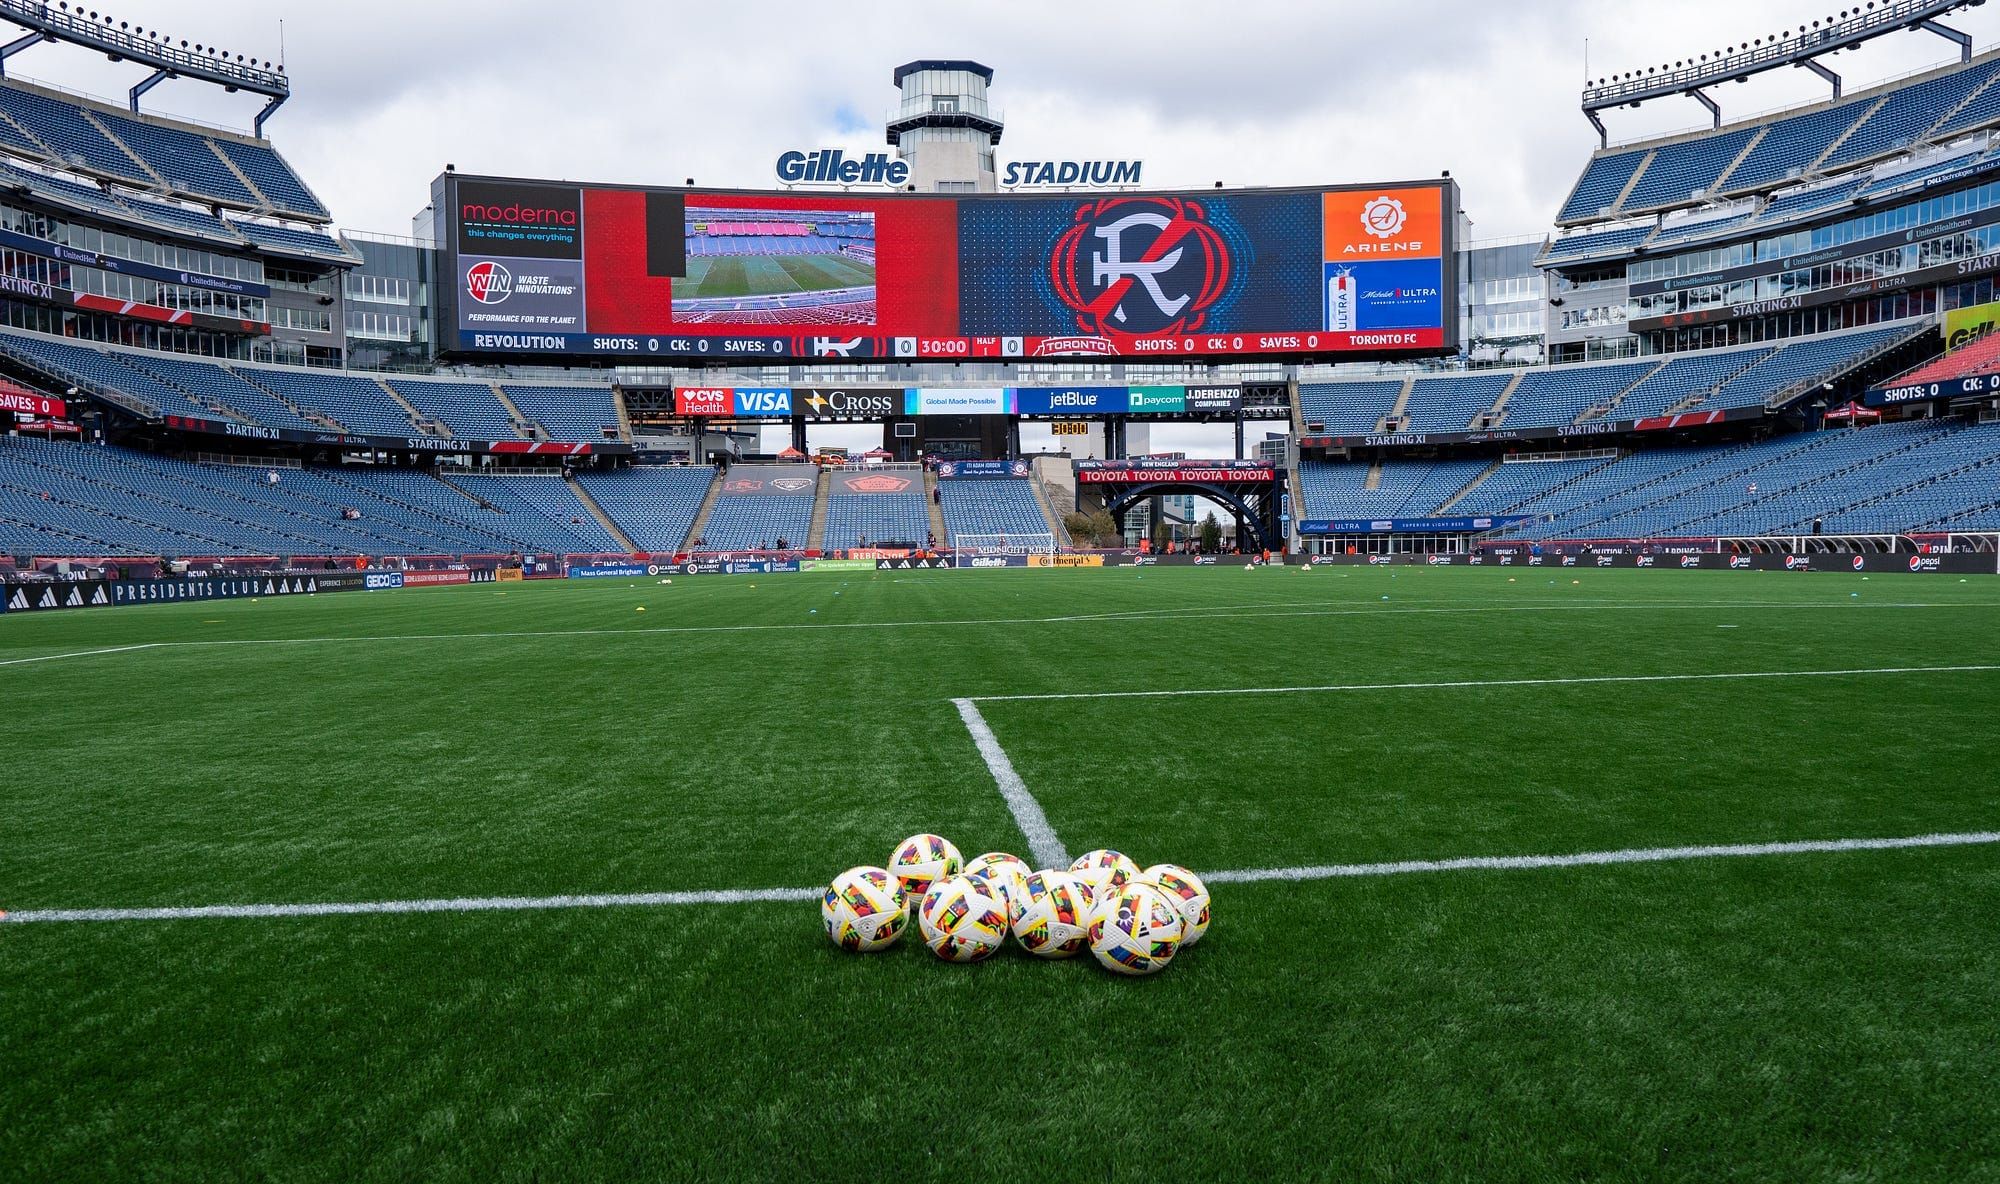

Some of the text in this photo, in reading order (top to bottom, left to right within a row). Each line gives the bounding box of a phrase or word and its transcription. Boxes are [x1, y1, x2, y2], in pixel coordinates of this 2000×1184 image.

[776, 149, 909, 184] Gillette
[1003, 161, 1142, 185] STADIUM
[463, 203, 576, 225] moderna
[1915, 216, 1973, 239] UnitedHealthcare
[468, 229, 573, 244] this changes everything
[1343, 242, 1421, 253] ARIENS
[1792, 249, 1843, 267] UnitedHealthcare
[471, 274, 508, 293] WIN
[518, 276, 549, 285] WASTE
[1672, 273, 1724, 288] UnitedHealthcare
[1878, 277, 1906, 289] ULTRA
[0, 277, 53, 300] RTING XI
[515, 285, 573, 296] INNOVATIONS
[1360, 288, 1437, 300] Michelob ULTRA
[1338, 293, 1348, 330] ULTRA
[1733, 296, 1802, 317] STARTING XI
[468, 313, 577, 326] PERFORMANCE FOR THE PLANET
[475, 334, 967, 354] REVOLUTION SHOTS: 0 CK: 0 SAVES: 0 0 30:00
[976, 337, 995, 345] HALF
[1006, 340, 1018, 353] 0
[1047, 340, 1107, 351] TORONTO
[1135, 333, 1417, 351] SHOTS: 0 CK: 0 SAVES: 0 TORONTO FC
[1186, 389, 1240, 400] J.DERENZO
[1885, 374, 2000, 402] SHOTS: 0 CK: 0
[696, 390, 725, 401] CVS
[736, 392, 790, 412] VISA
[926, 397, 997, 405] Global Made Possible
[1049, 392, 1098, 409] jetBlue
[1144, 397, 1183, 406] paycom
[0, 394, 50, 413] SAVES: 0
[225, 423, 280, 440] STARTING XI
[1054, 422, 1087, 435] 30:00
[1557, 422, 1617, 436] STARTING XI
[344, 435, 367, 444] ULTRA
[1365, 434, 1426, 446] STARTING XI
[1493, 431, 1517, 440] ULTRA
[408, 438, 470, 450] STARTING XI
[1085, 471, 1270, 481] TOYOTA TOYOTA TOYOTA TOYOTA
[971, 557, 1008, 567] Gillette
[1142, 556, 1157, 565] pepsi
[1202, 556, 1217, 564] pepsi
[1737, 555, 1751, 565] pepsi
[1794, 556, 1809, 565] pepsi
[1921, 556, 1940, 567] pepsi
[597, 568, 619, 577] General
[619, 568, 643, 578] Brigham
[366, 574, 390, 588] GEICO
[116, 580, 259, 601] PRESIDENTS CLUB
